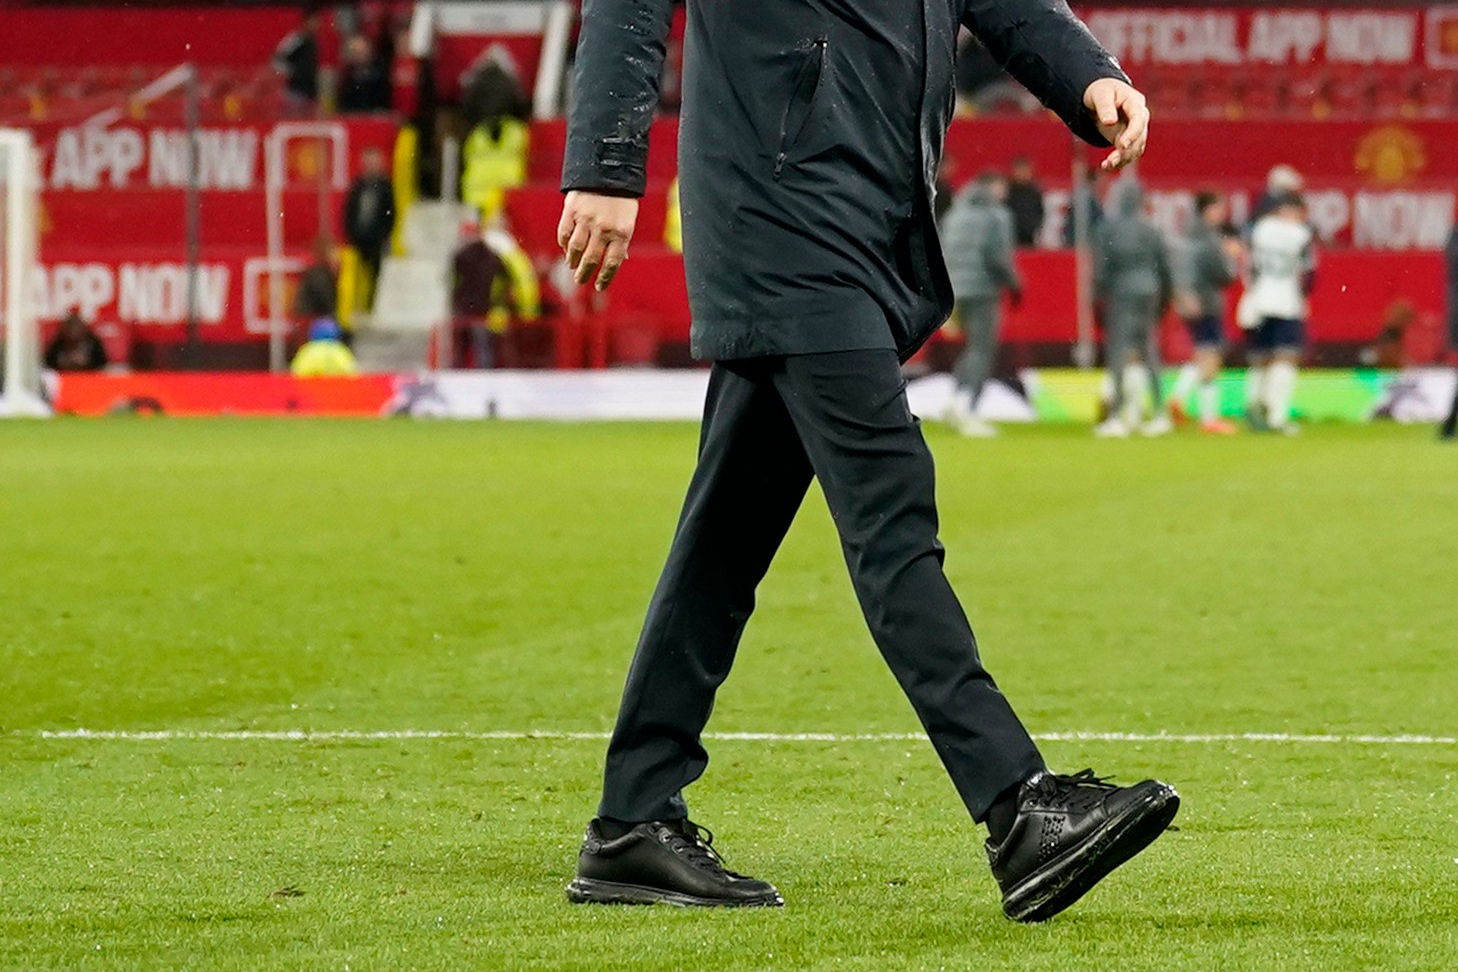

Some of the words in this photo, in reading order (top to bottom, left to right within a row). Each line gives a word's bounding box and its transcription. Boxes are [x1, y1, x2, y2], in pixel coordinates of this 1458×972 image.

[1247, 10, 1322, 65] APP
[1326, 10, 1415, 65] NOW
[51, 128, 144, 190] APP
[1353, 190, 1456, 251] NOW
[117, 262, 230, 324] NOW
